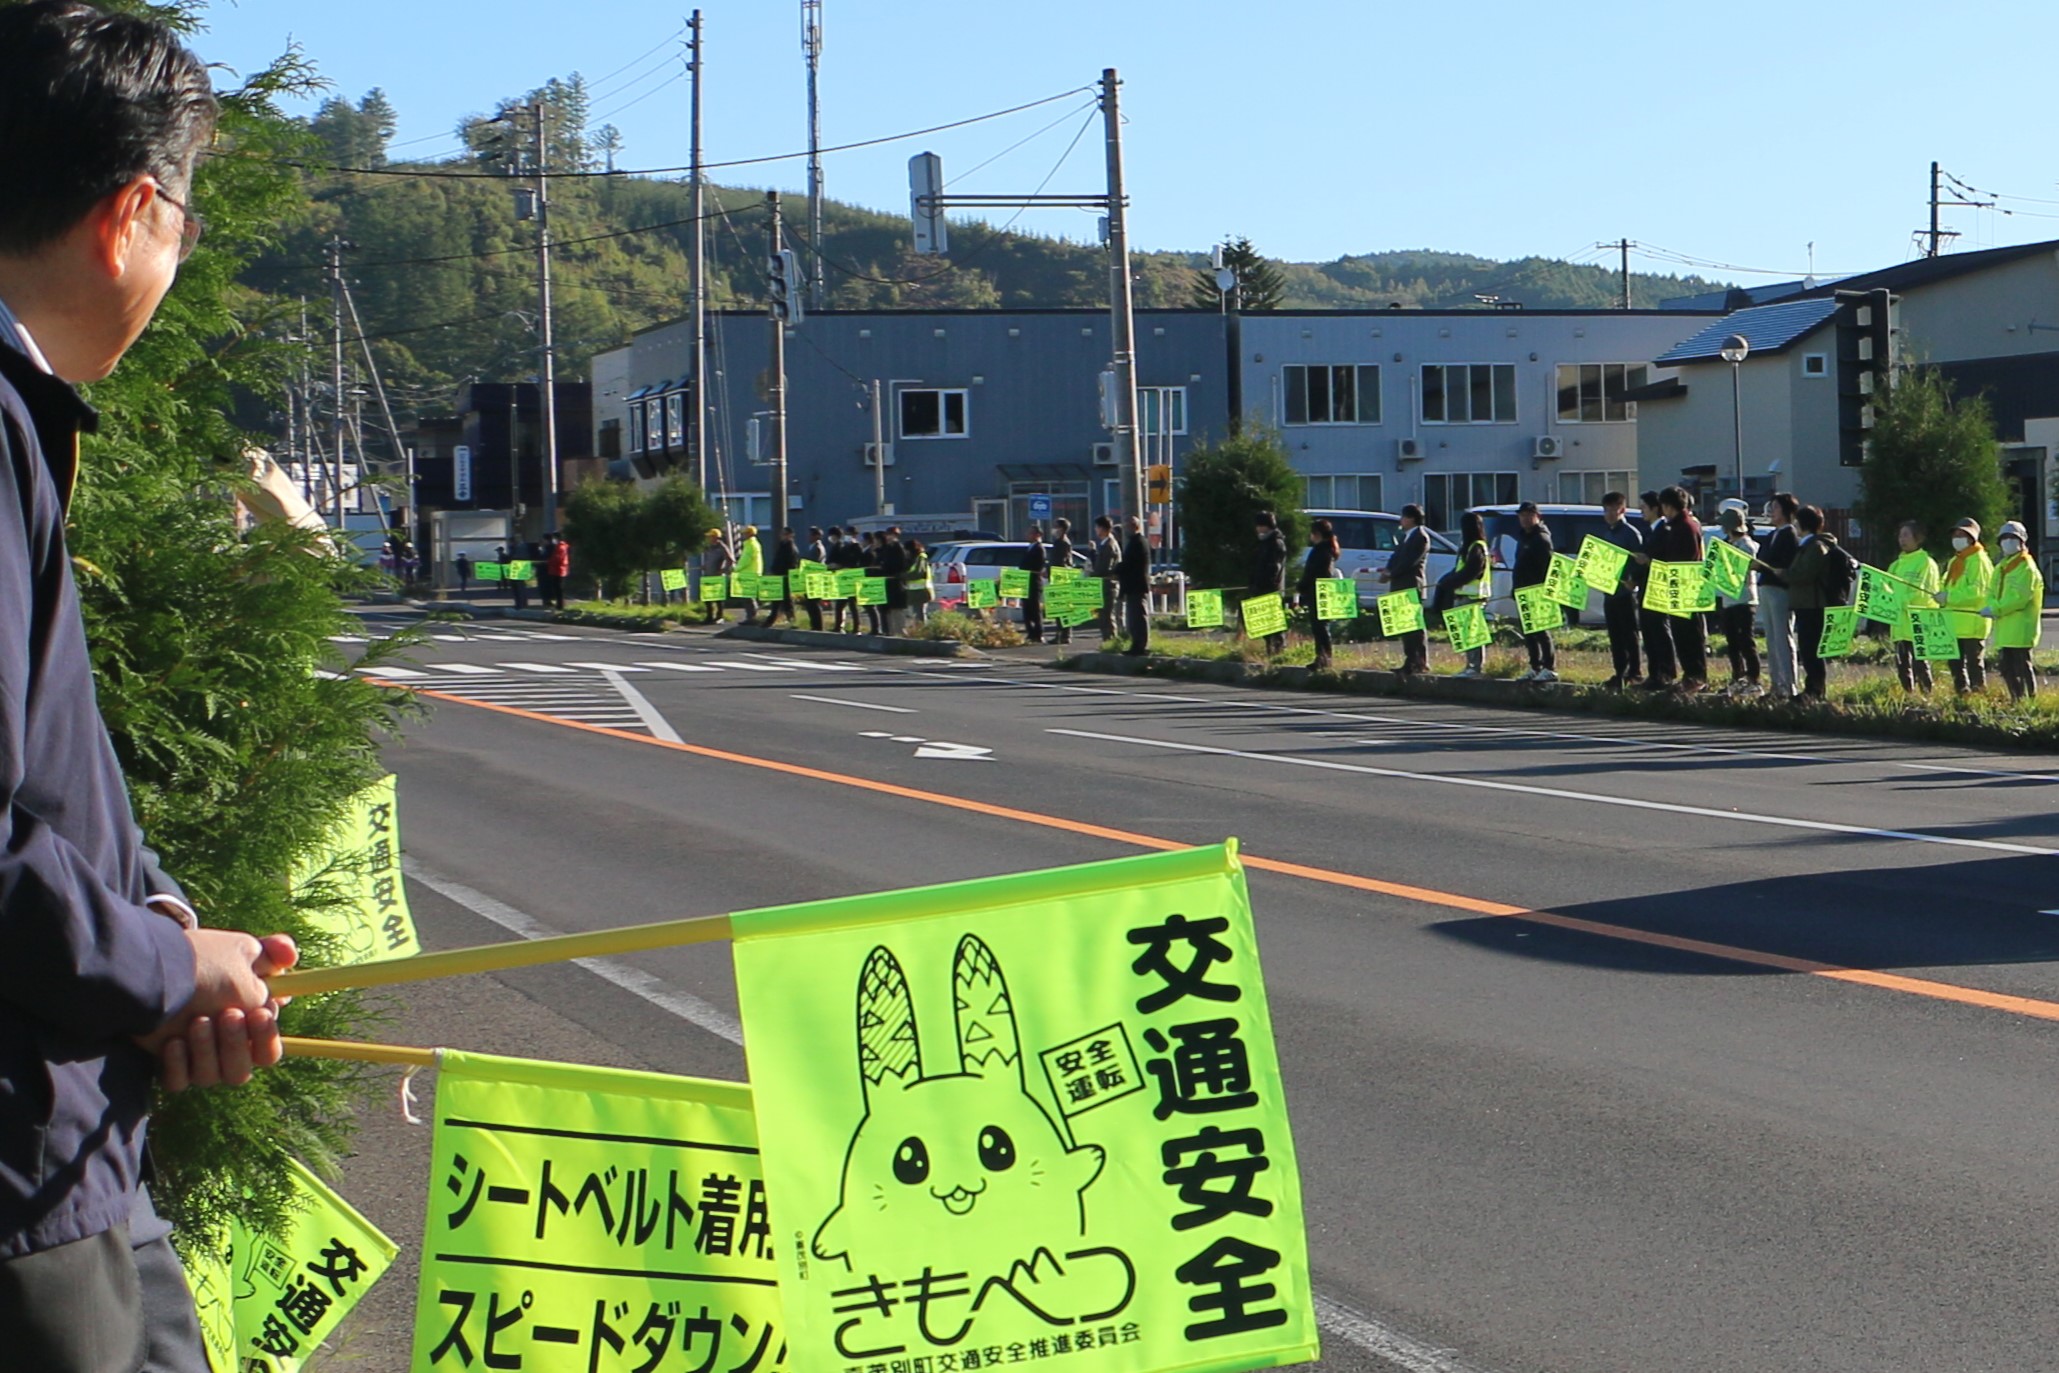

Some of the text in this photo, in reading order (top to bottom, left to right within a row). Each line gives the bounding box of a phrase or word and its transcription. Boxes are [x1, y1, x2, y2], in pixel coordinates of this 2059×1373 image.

[1055, 1040, 1116, 1078] 安全
[1064, 1063, 1127, 1105] 運転
[1127, 914, 1288, 1342] 交通安全
[446, 1153, 775, 1261] シートベルト着用
